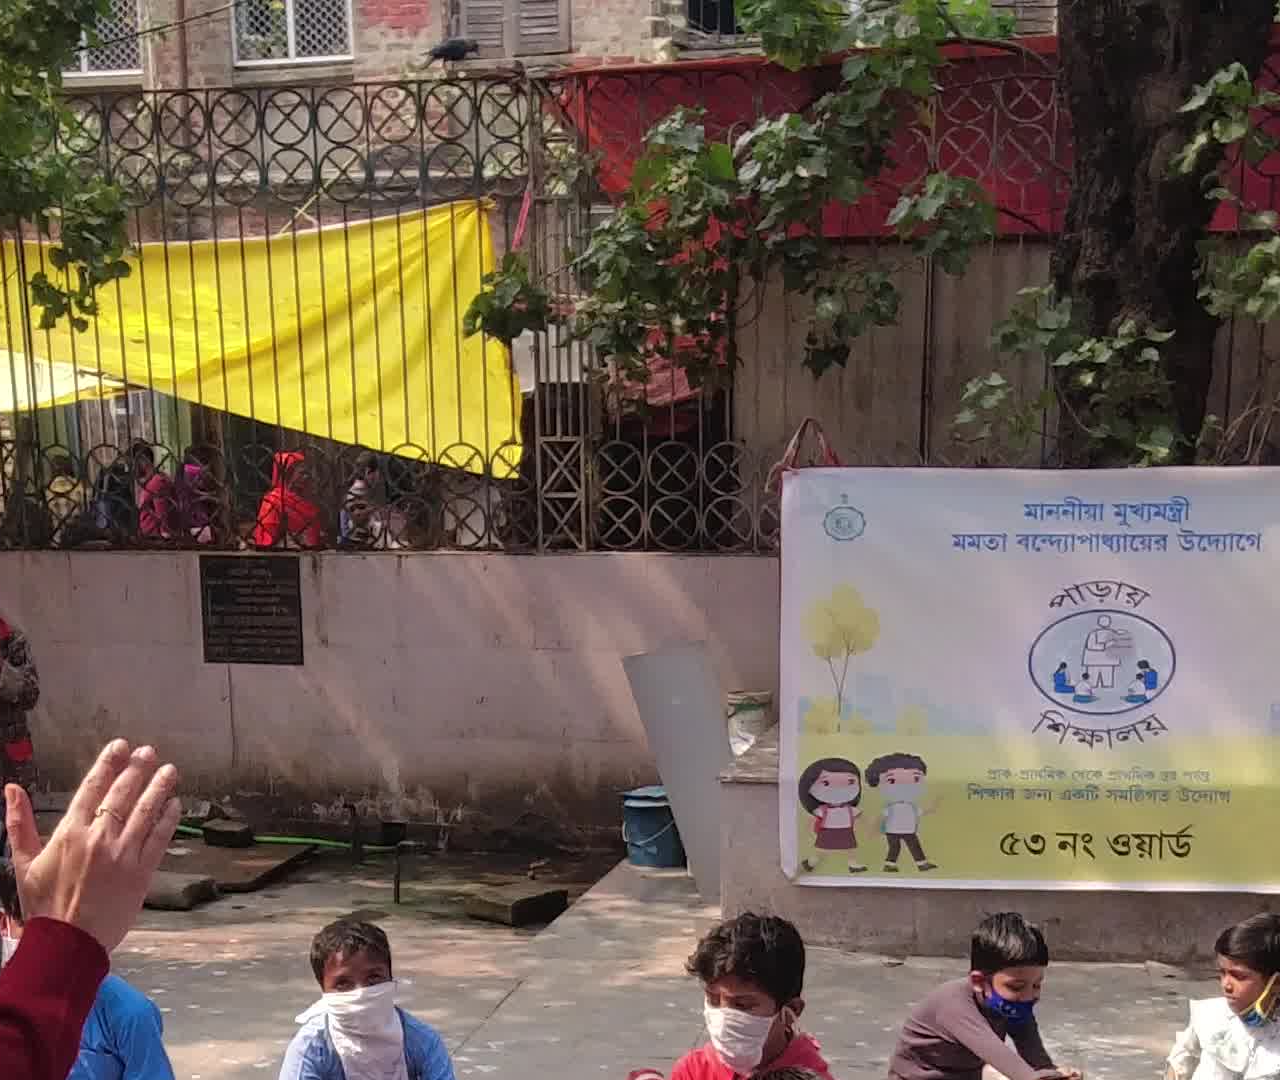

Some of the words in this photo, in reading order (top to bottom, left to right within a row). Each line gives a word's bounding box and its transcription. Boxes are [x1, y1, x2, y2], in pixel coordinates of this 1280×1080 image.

[1024, 497, 1104, 521] মাননীয়া
[1113, 496, 1191, 527] মুখ্যমন্ত্রী
[952, 533, 1007, 552] মমতা
[1016, 533, 1168, 554] বন্দ্যোপাধ্যায়ের
[1177, 528, 1262, 553] উদ্যোগে
[1049, 580, 1151, 608] পাড়ায়
[1031, 710, 1168, 749] শিক্ষালয়
[1000, 832, 1046, 855] ৫৩
[1056, 832, 1096, 859] নং
[1106, 824, 1194, 859] ওয়ার্ড
